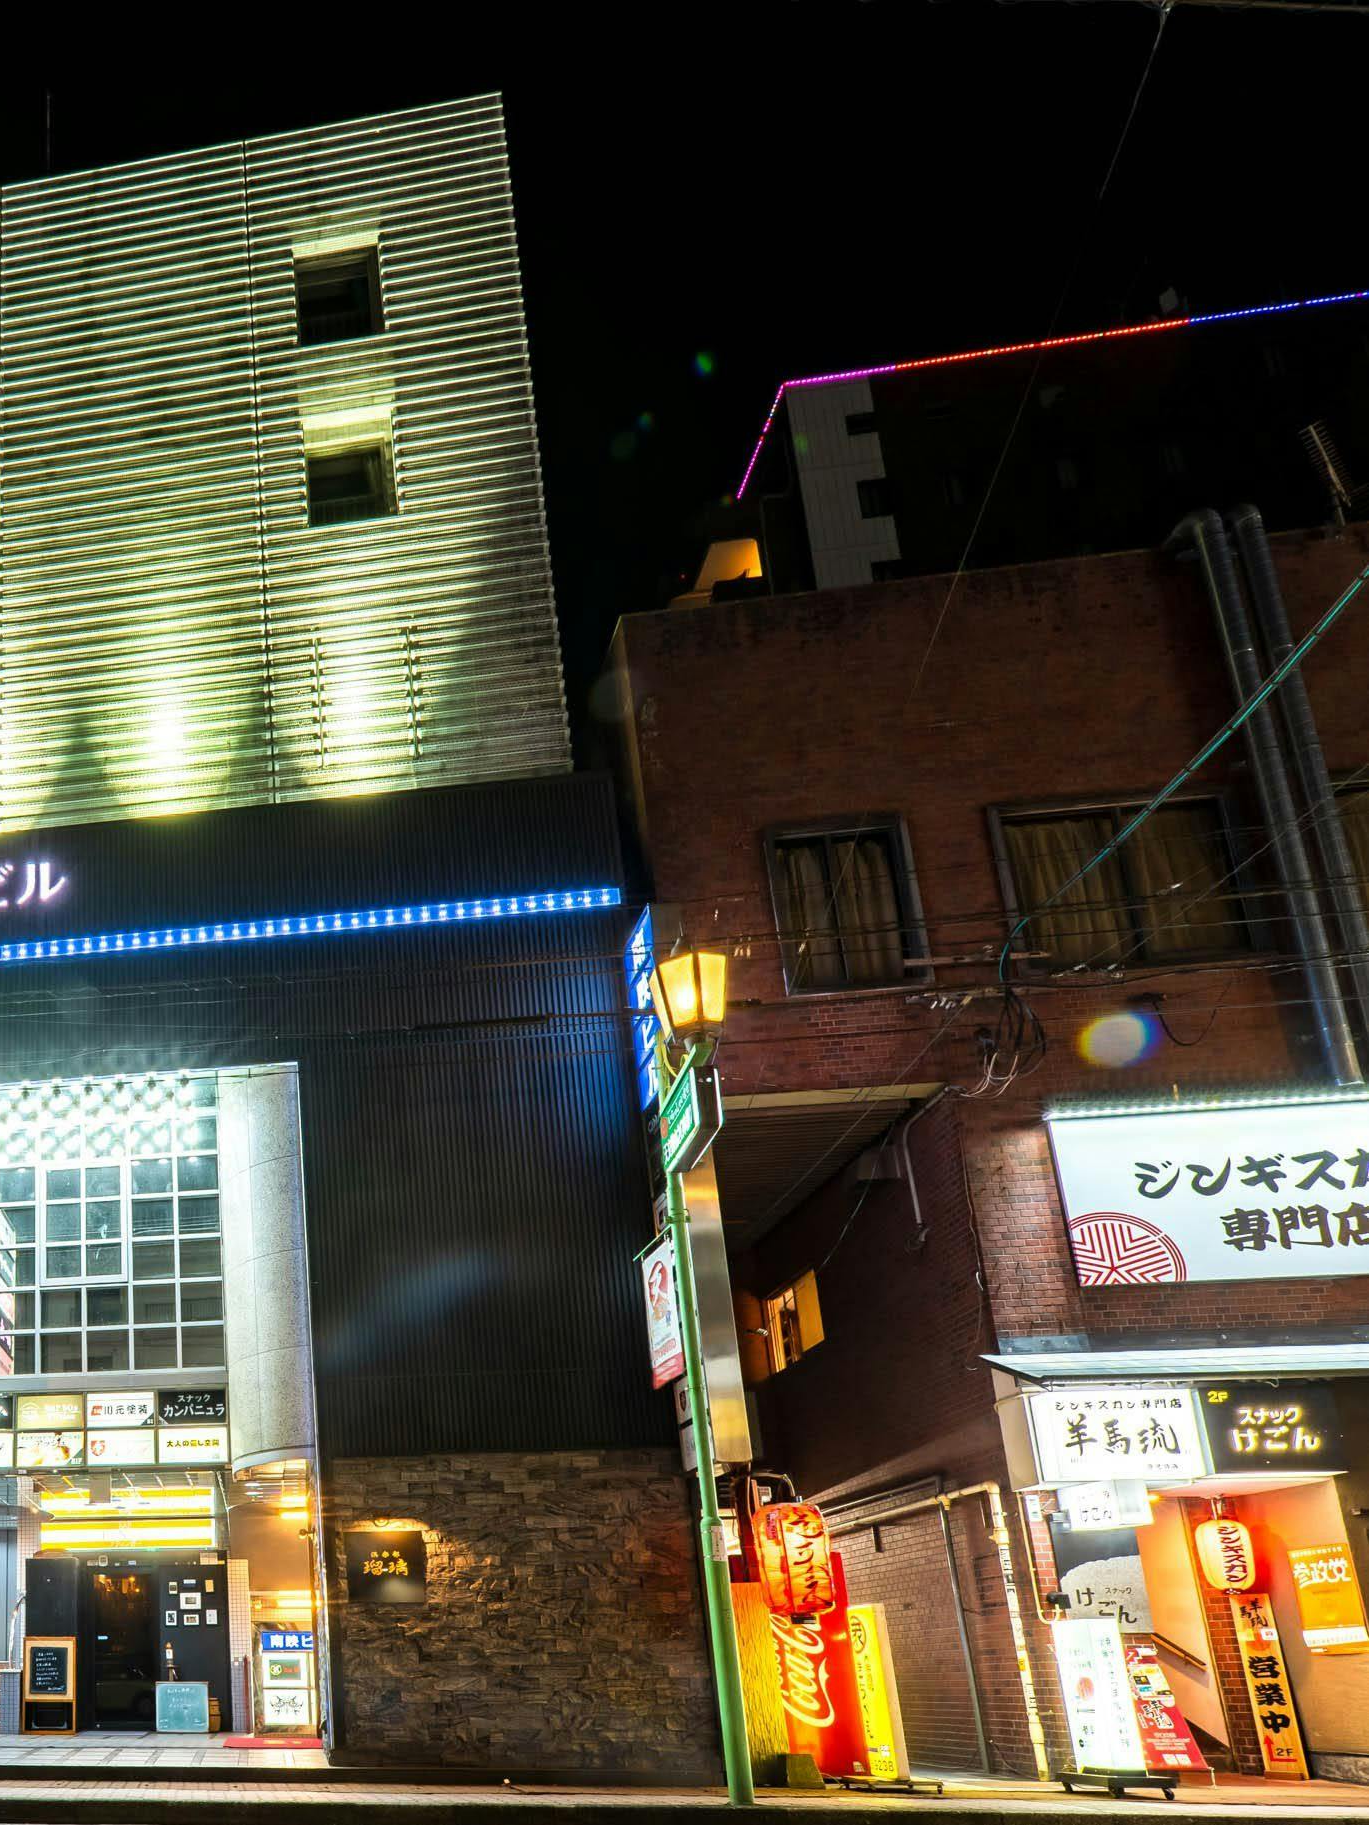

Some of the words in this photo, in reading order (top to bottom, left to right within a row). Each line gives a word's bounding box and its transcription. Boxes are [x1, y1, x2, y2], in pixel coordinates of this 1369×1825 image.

[177, 1394, 212, 1403] スナック
[1207, 1390, 1229, 1403] 2F
[163, 1403, 225, 1418] カンパニュラ
[1237, 1406, 1302, 1425] スナック
[1231, 1425, 1321, 1453] けごん
[1076, 1587, 1138, 1624] けごん
[1248, 1655, 1292, 1735] 営業中
[1275, 1747, 1294, 1757] 2F
